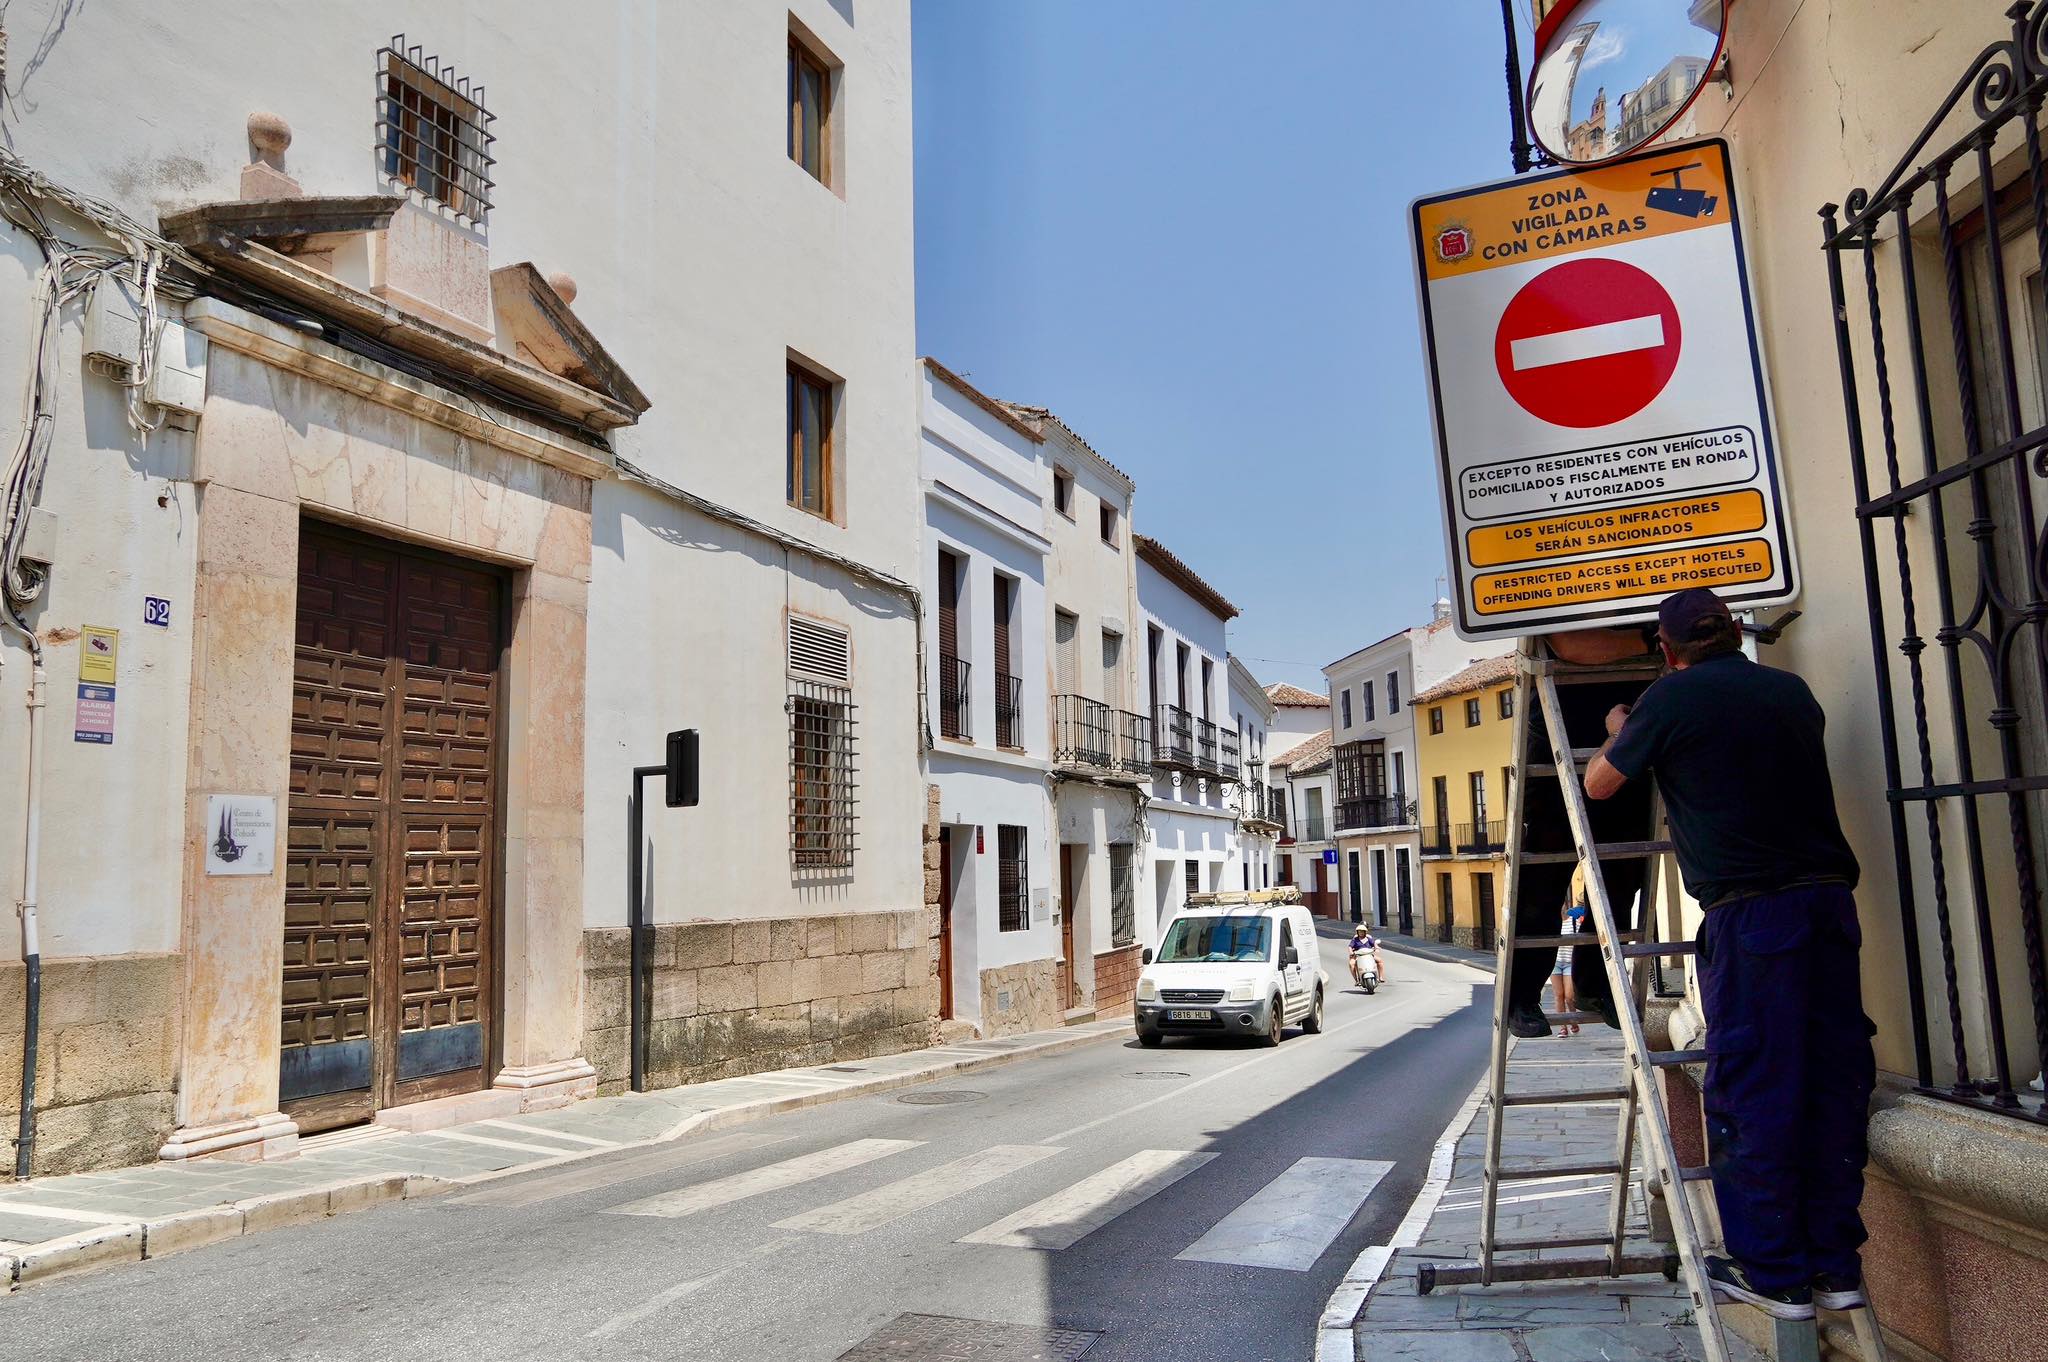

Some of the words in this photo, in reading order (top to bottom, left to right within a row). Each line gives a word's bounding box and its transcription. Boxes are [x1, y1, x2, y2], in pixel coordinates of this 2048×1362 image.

[1528, 187, 1587, 211] ZONA
[1512, 203, 1610, 234] VIGILADA
[1482, 239, 1528, 260] CON
[1536, 216, 1647, 249] CÁMARAS
[1469, 465, 1531, 483] EXCEPTO
[1536, 450, 1622, 473] RESIDENTES
[1627, 446, 1658, 459] CON
[1663, 433, 1743, 454] VEHÍCULOS
[1468, 476, 1565, 499] DOMICILIADOS
[1569, 461, 1667, 484] FISCALMENTE
[1671, 457, 1691, 469] EN
[1696, 449, 1748, 465] RONDA
[1549, 493, 1558, 503] Y
[1565, 477, 1665, 501] AUTORIZADOS
[1505, 527, 1532, 540] LOS
[1538, 516, 1614, 535] VEHÍCULOS
[1619, 502, 1720, 525] INFRACTORES
[1535, 535, 1582, 552] SERÁN
[1587, 522, 1692, 545] SANCIONADOS
[1483, 588, 1552, 605] OFFENDING
[1557, 581, 1611, 596] DRIVERS
[1615, 577, 1646, 589] WILL
[1650, 574, 1667, 585] BE
[1672, 562, 1762, 582] PROSECUTED
[1494, 571, 1572, 589] RESTRICTED
[1577, 563, 1630, 579] ACCESS
[1635, 556, 1686, 571] EXCEPT
[1692, 548, 1745, 564] HOTELS
[145, 600, 169, 623] 62
[80, 702, 111, 711] ALARMA
[1172, 1011, 1191, 1019] 6816
